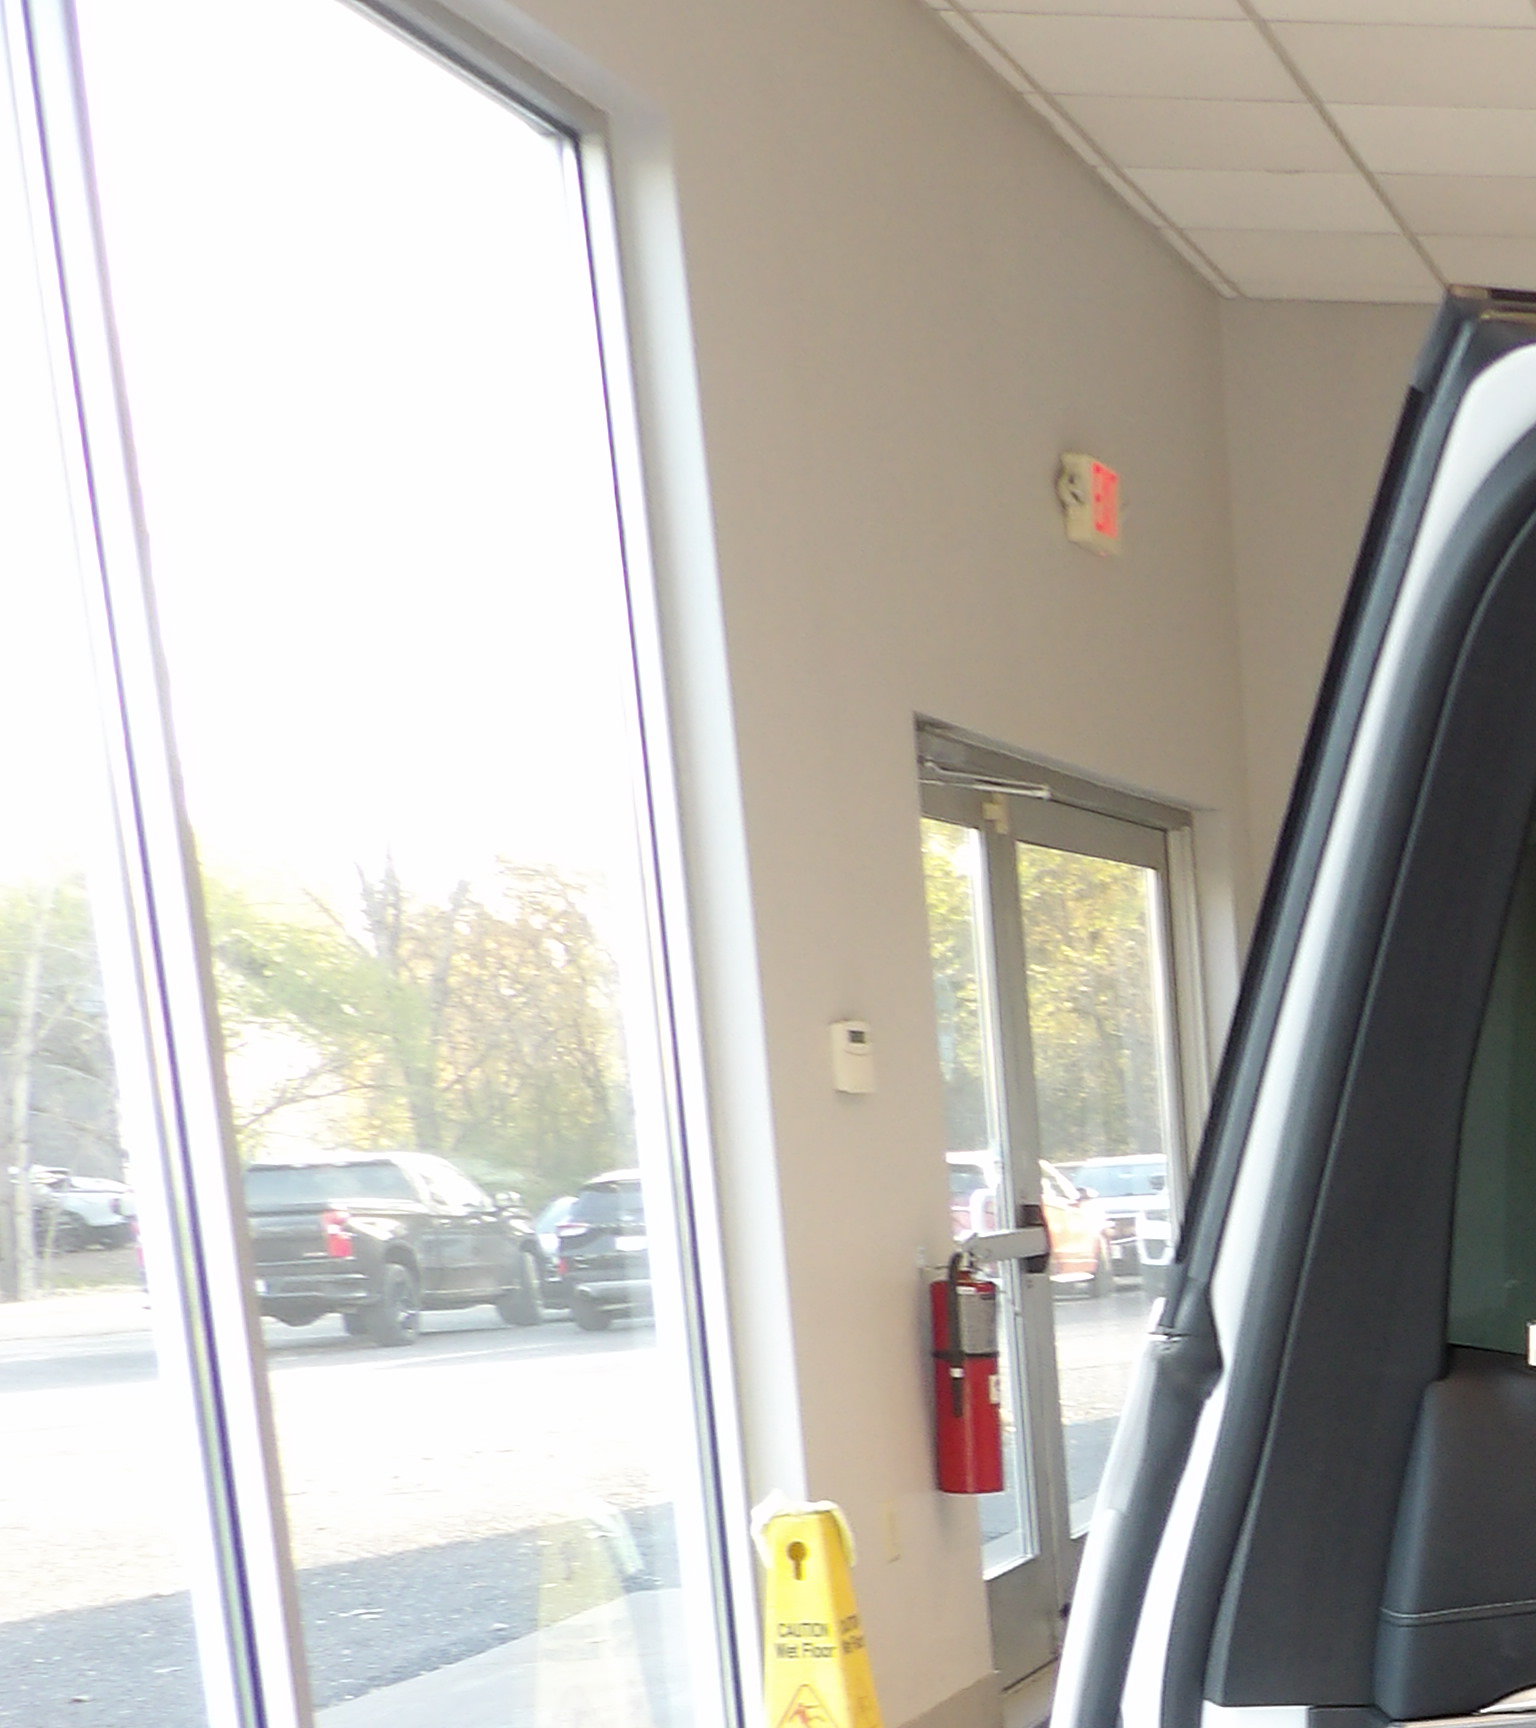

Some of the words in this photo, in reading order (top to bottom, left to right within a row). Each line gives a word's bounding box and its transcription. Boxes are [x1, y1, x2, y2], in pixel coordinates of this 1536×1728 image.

[779, 1623, 828, 1637] CAUTION
[775, 1642, 798, 1658] Wet
[800, 1642, 836, 1658] Floor
